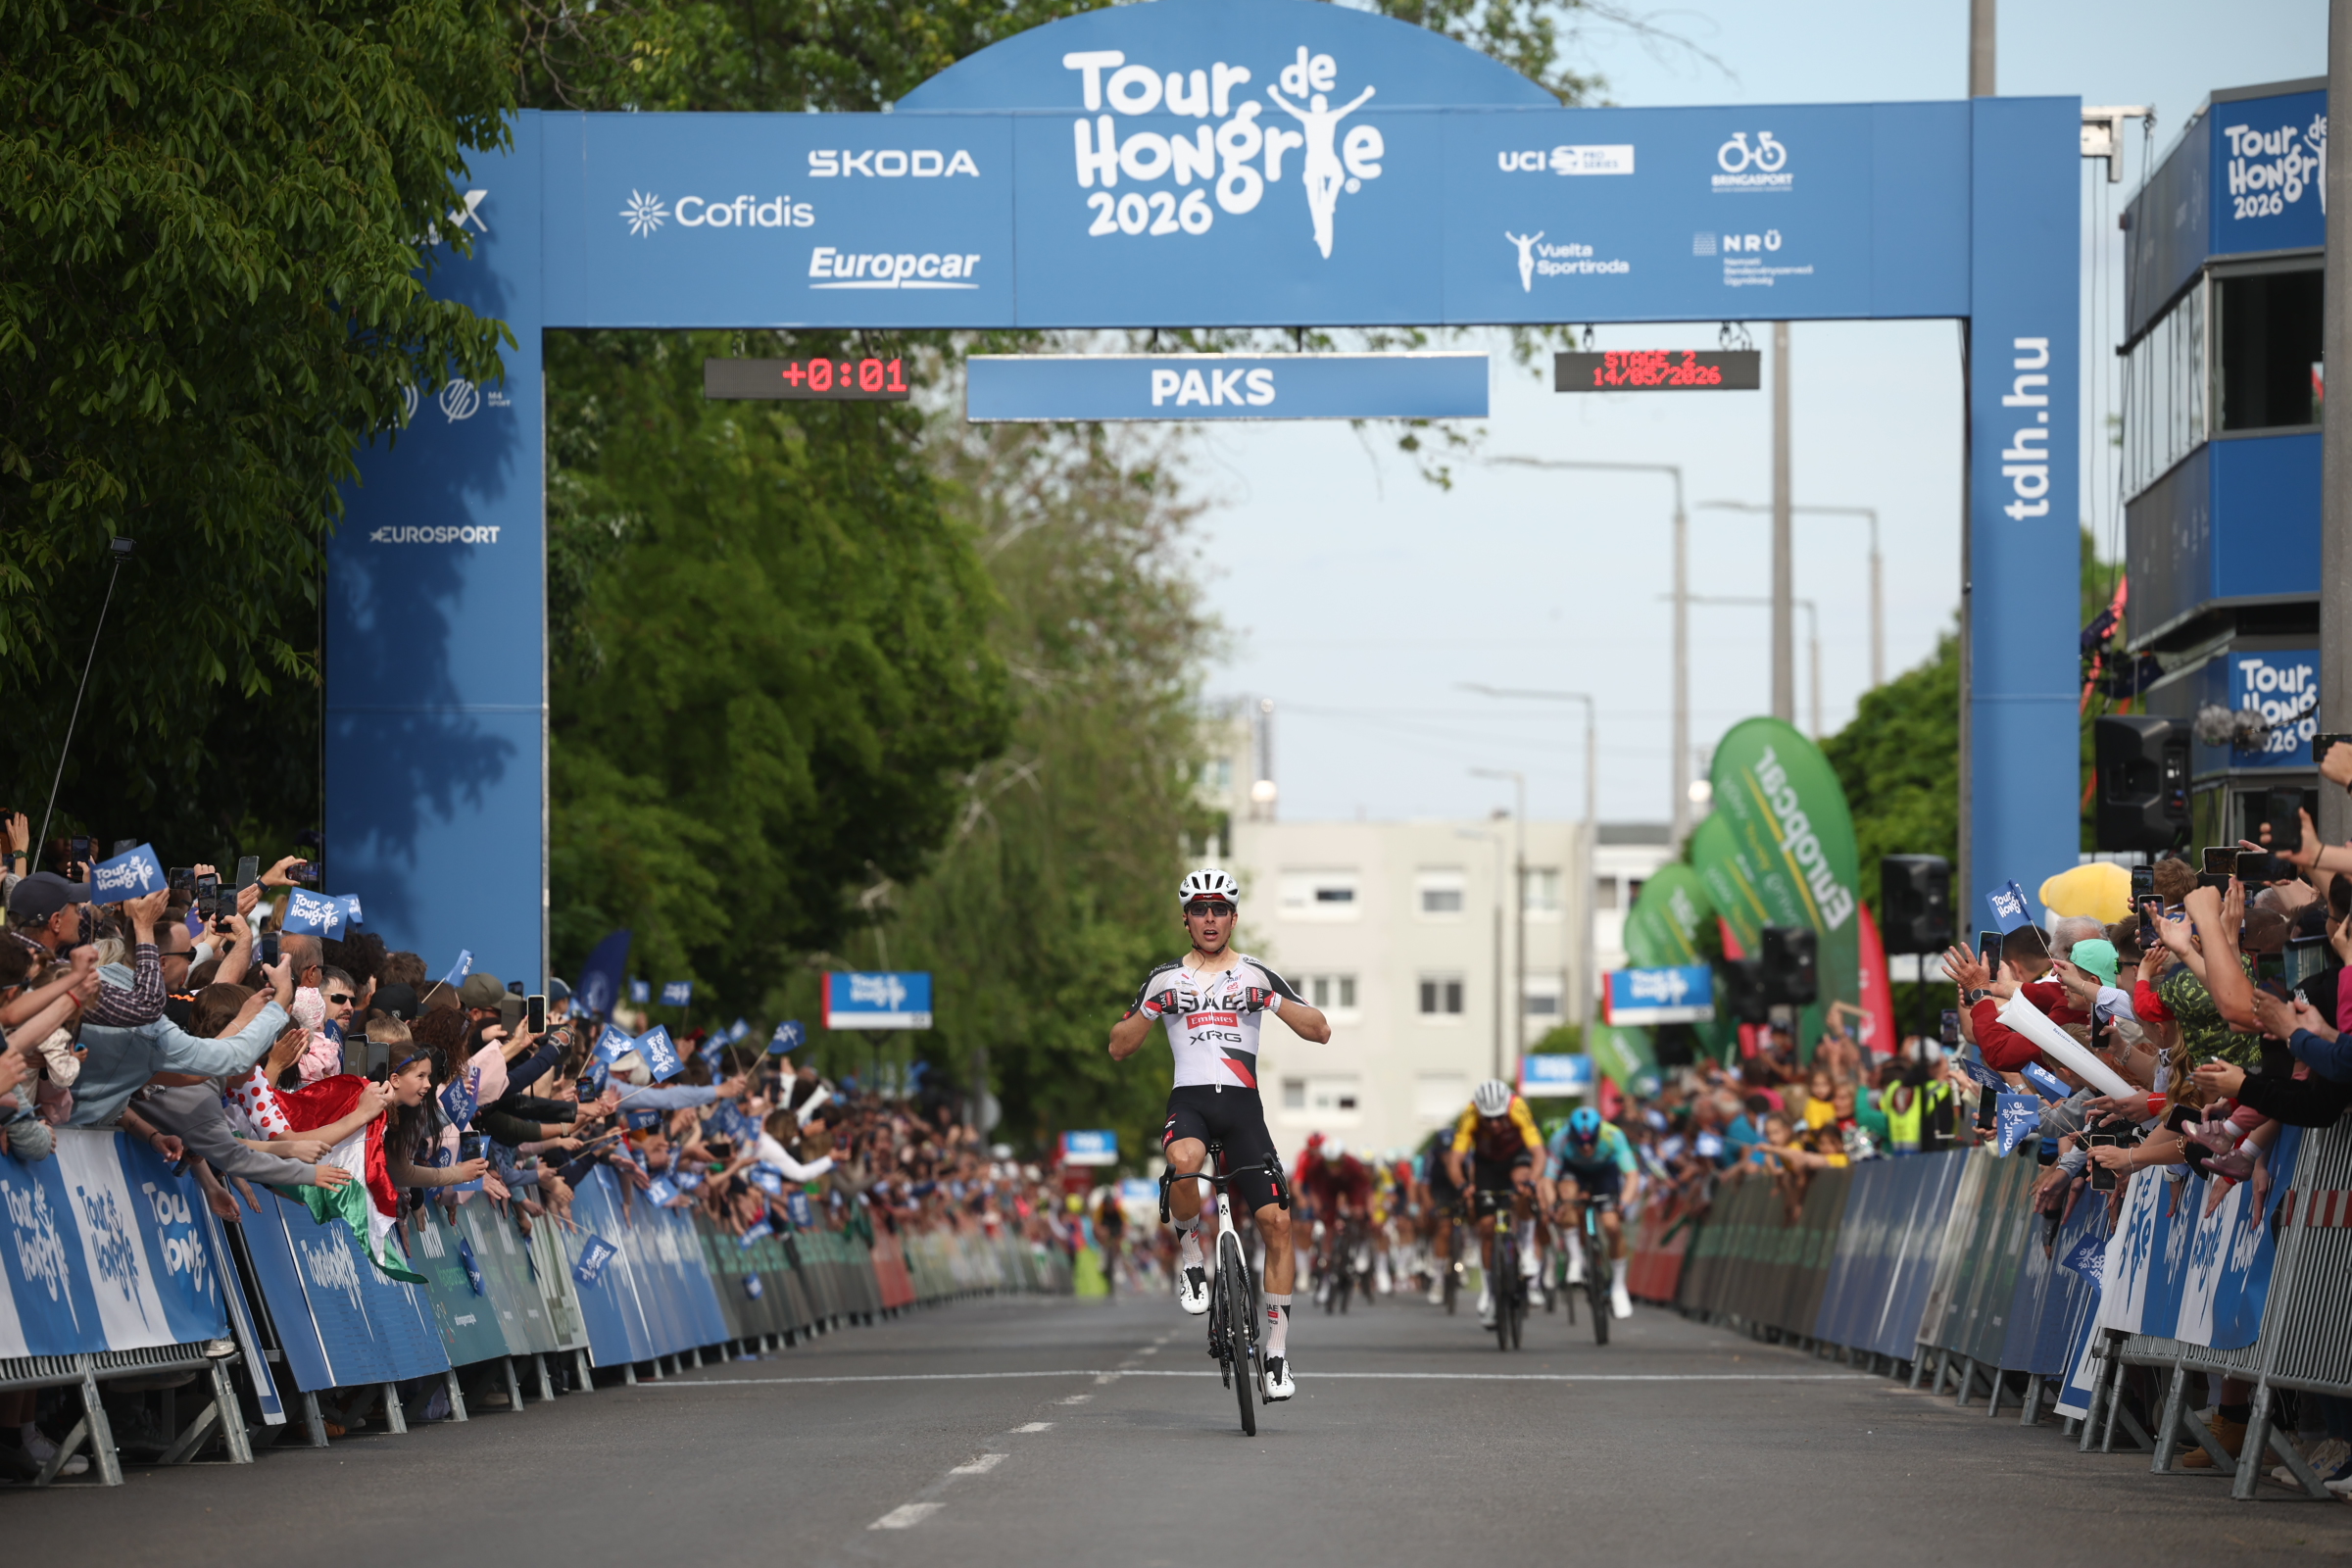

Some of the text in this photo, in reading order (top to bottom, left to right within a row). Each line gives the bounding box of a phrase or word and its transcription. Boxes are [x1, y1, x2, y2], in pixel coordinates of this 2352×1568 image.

[1062, 45, 1337, 119] Tour de
[2224, 123, 2298, 157] Tour
[1497, 150, 1546, 172] UCI
[1711, 173, 1794, 187] BRINGASPORT
[674, 195, 816, 228] Cofidis
[1087, 187, 1214, 237] 2026
[2233, 190, 2283, 220] 2026
[1536, 242, 1593, 259] Vuelta
[1722, 228, 1783, 253] NRÜ
[808, 247, 981, 288] Europcar
[1536, 259, 1631, 277] Sportiroda
[782, 358, 908, 392] +0:01
[1151, 368, 1277, 407] PAKS
[2002, 336, 2050, 521] tdh.hu
[369, 525, 502, 544] EUROSPORT
[2237, 658, 2314, 694] Tour
[92, 862, 127, 880] Tour
[295, 893, 321, 910] Tour
[1991, 891, 2012, 906] Tour
[656, 1031, 669, 1054] Tour
[1189, 1030, 1243, 1047] XRG
[2003, 1123, 2014, 1152] Tour
[0, 1179, 36, 1230] Tour
[75, 1185, 109, 1233] Tour
[142, 1182, 192, 1226] Tou
